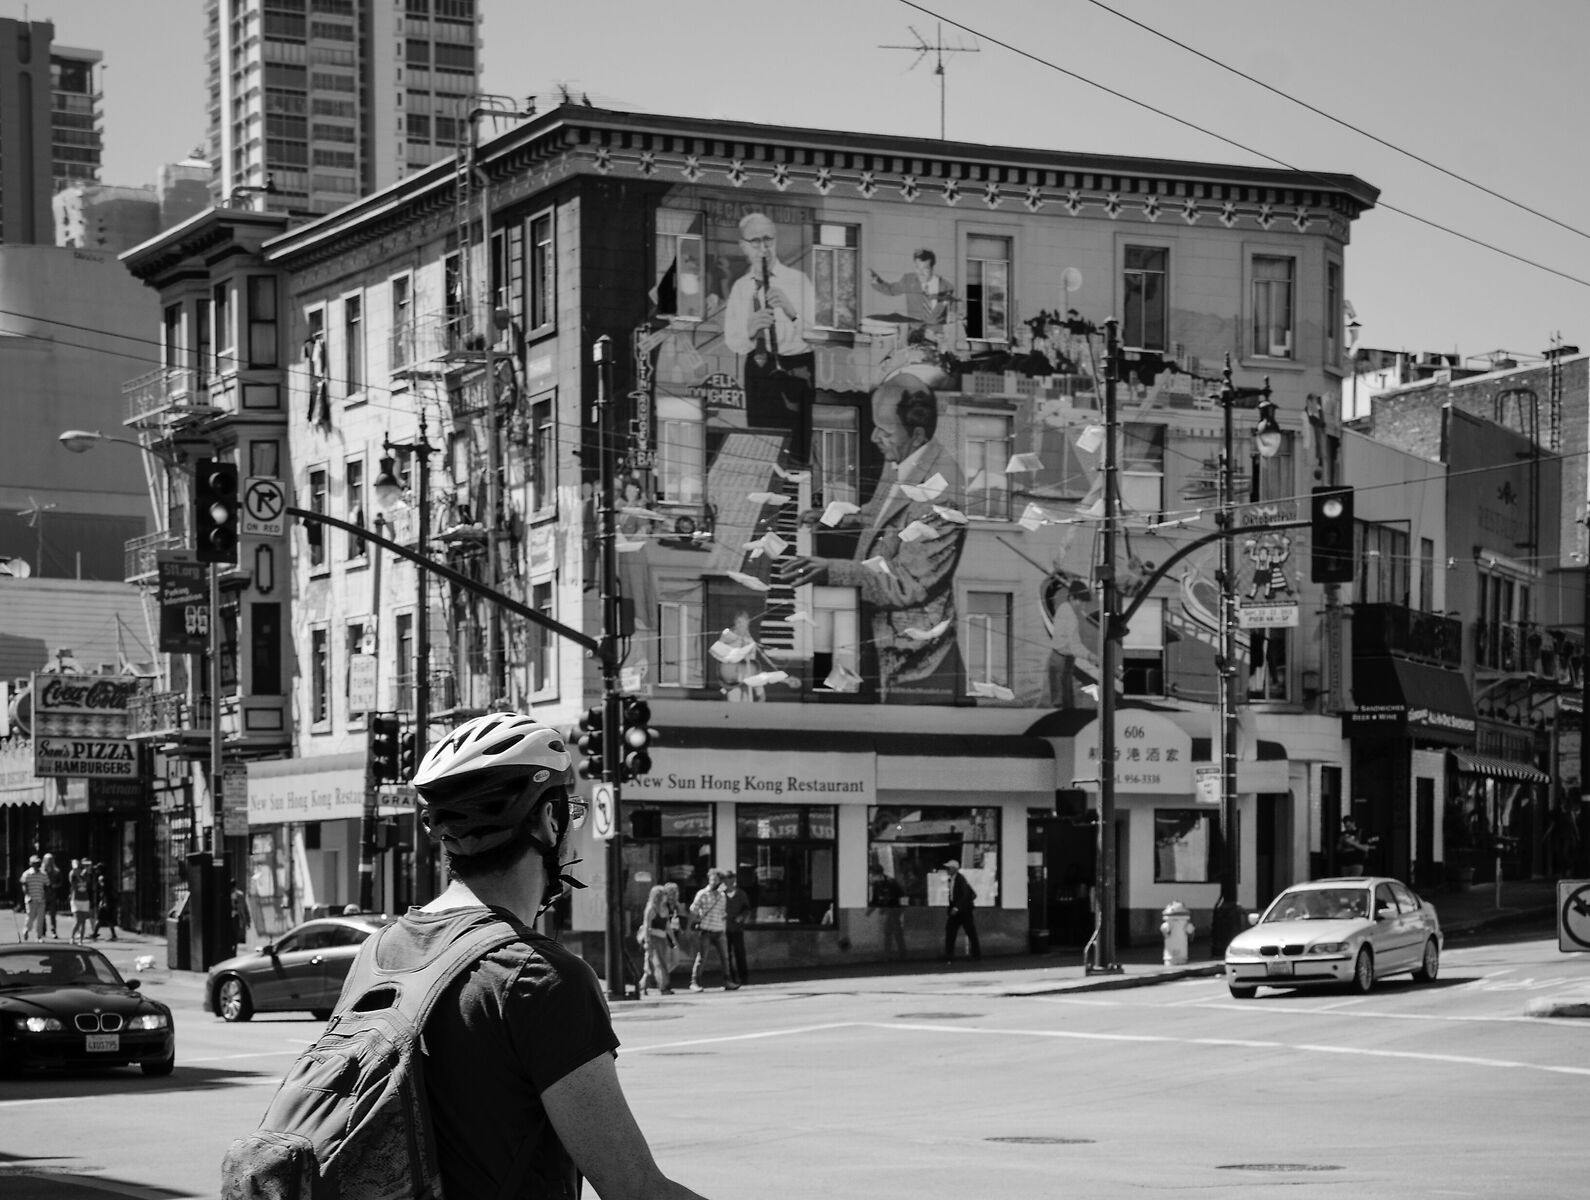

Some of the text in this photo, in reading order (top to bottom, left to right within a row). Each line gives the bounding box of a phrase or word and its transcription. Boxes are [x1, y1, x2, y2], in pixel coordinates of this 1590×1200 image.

[246, 522, 280, 532] ON RED
[1124, 726, 1145, 738] 606
[71, 742, 135, 760] PIZZA
[55, 761, 131, 774] HAMBURGERS
[668, 774, 696, 789] Sun
[701, 775, 741, 794] Hong
[745, 776, 783, 794] Kong
[787, 777, 864, 792] Restaurant
